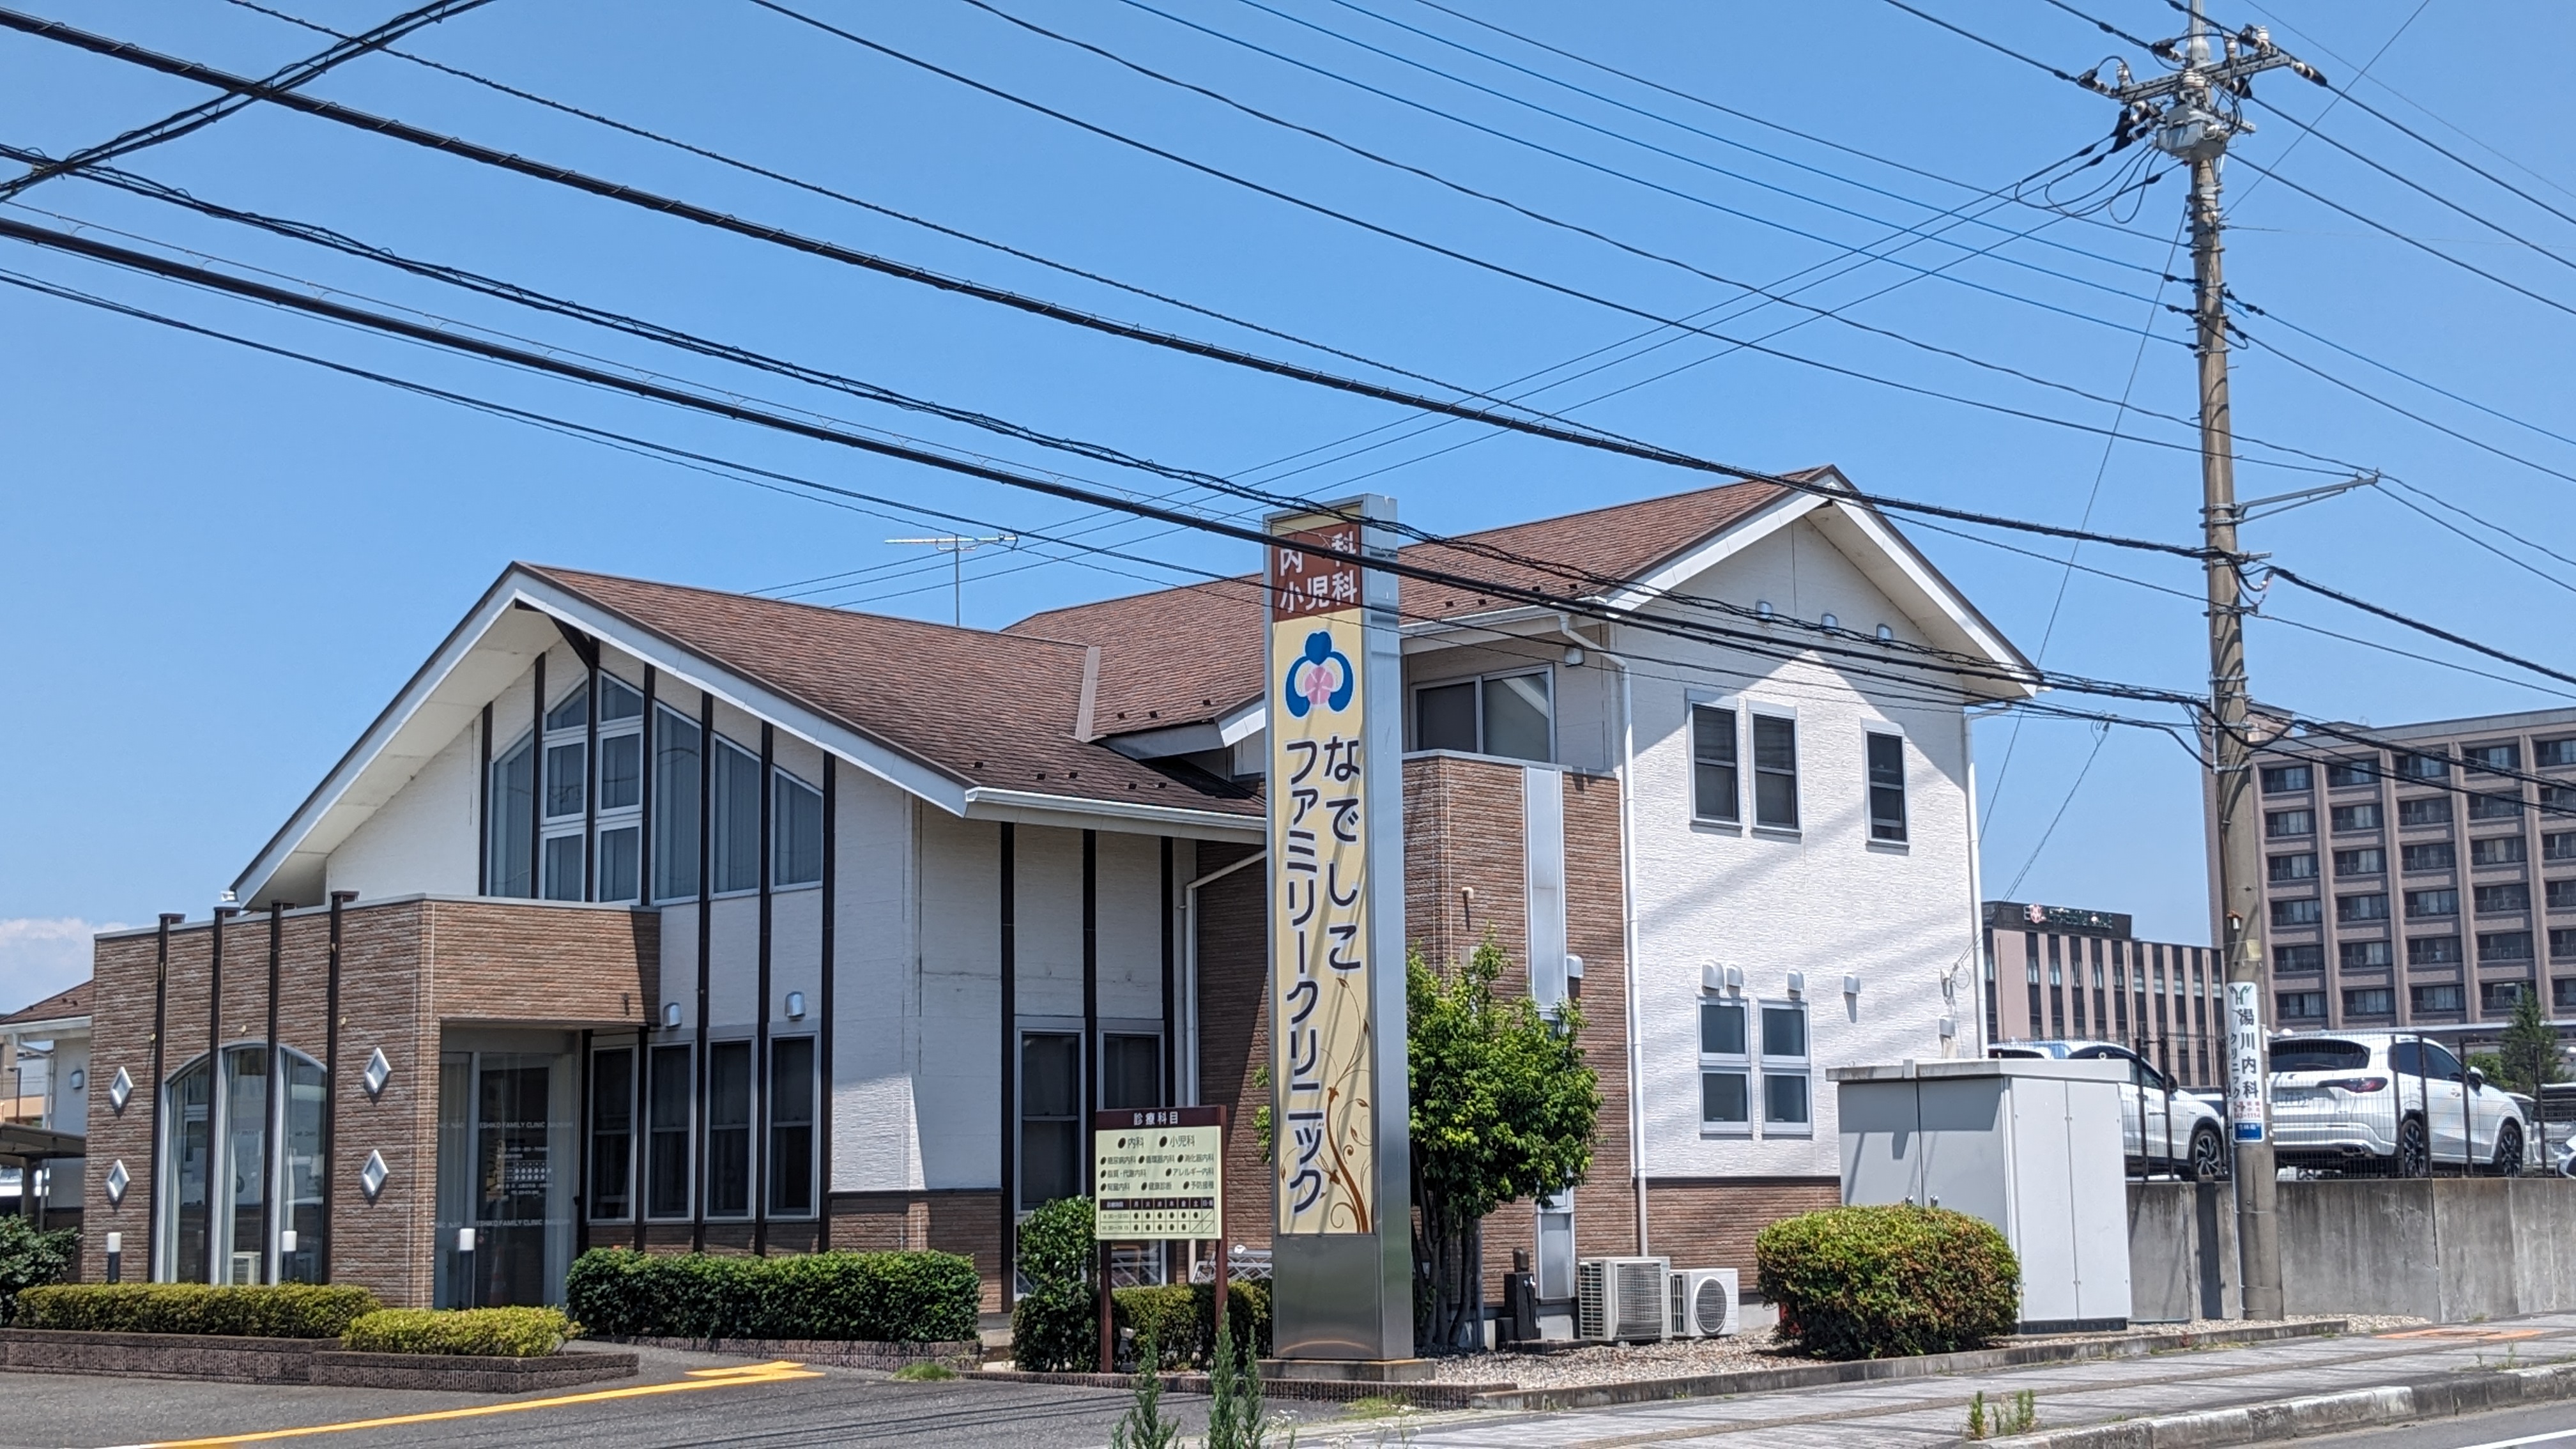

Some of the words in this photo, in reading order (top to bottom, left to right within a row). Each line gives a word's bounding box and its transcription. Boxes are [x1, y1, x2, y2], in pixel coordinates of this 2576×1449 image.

[1279, 530, 1356, 576] 内科
[1280, 569, 1358, 613] 小児科
[1324, 735, 1361, 970] なでしこ
[1286, 740, 1324, 1214] ファミリークリニック
[2231, 1032, 2240, 1099] クリニック
[2238, 1008, 2258, 1098] 湯川内科
[1133, 1111, 1179, 1126] 診療科目
[1170, 1135, 1195, 1147] 小児科
[1128, 1137, 1144, 1149] 内科
[1173, 1167, 1214, 1176] アレルギー内科
